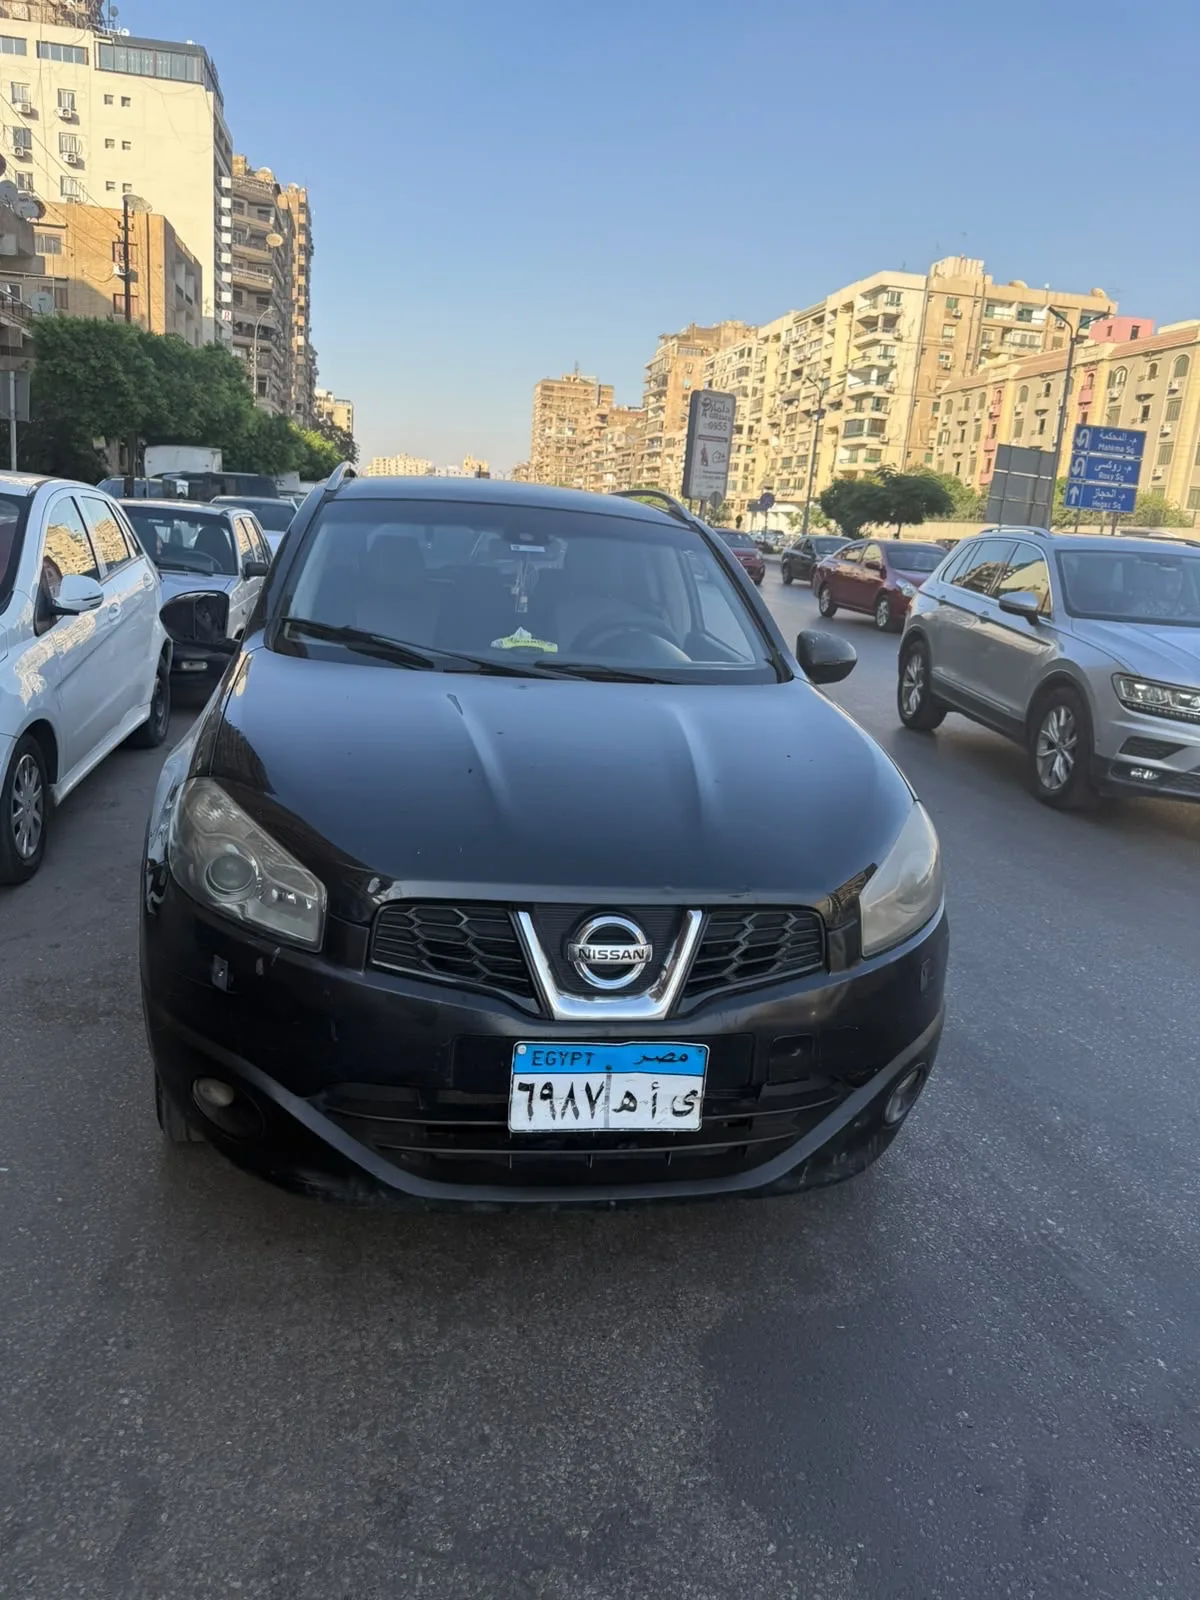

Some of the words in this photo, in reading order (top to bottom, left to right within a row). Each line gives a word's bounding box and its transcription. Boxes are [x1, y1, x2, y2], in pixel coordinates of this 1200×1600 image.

[1099, 429, 1127, 441] المحكمة
[1098, 472, 1114, 480] Roxy
[1092, 488, 1117, 500] الحجاز
[578, 949, 644, 960] NISSAN
[531, 1050, 596, 1067] EGYPT
[633, 1049, 689, 1065] مصر
[517, 1081, 605, 1122] ٦٩٨٧
